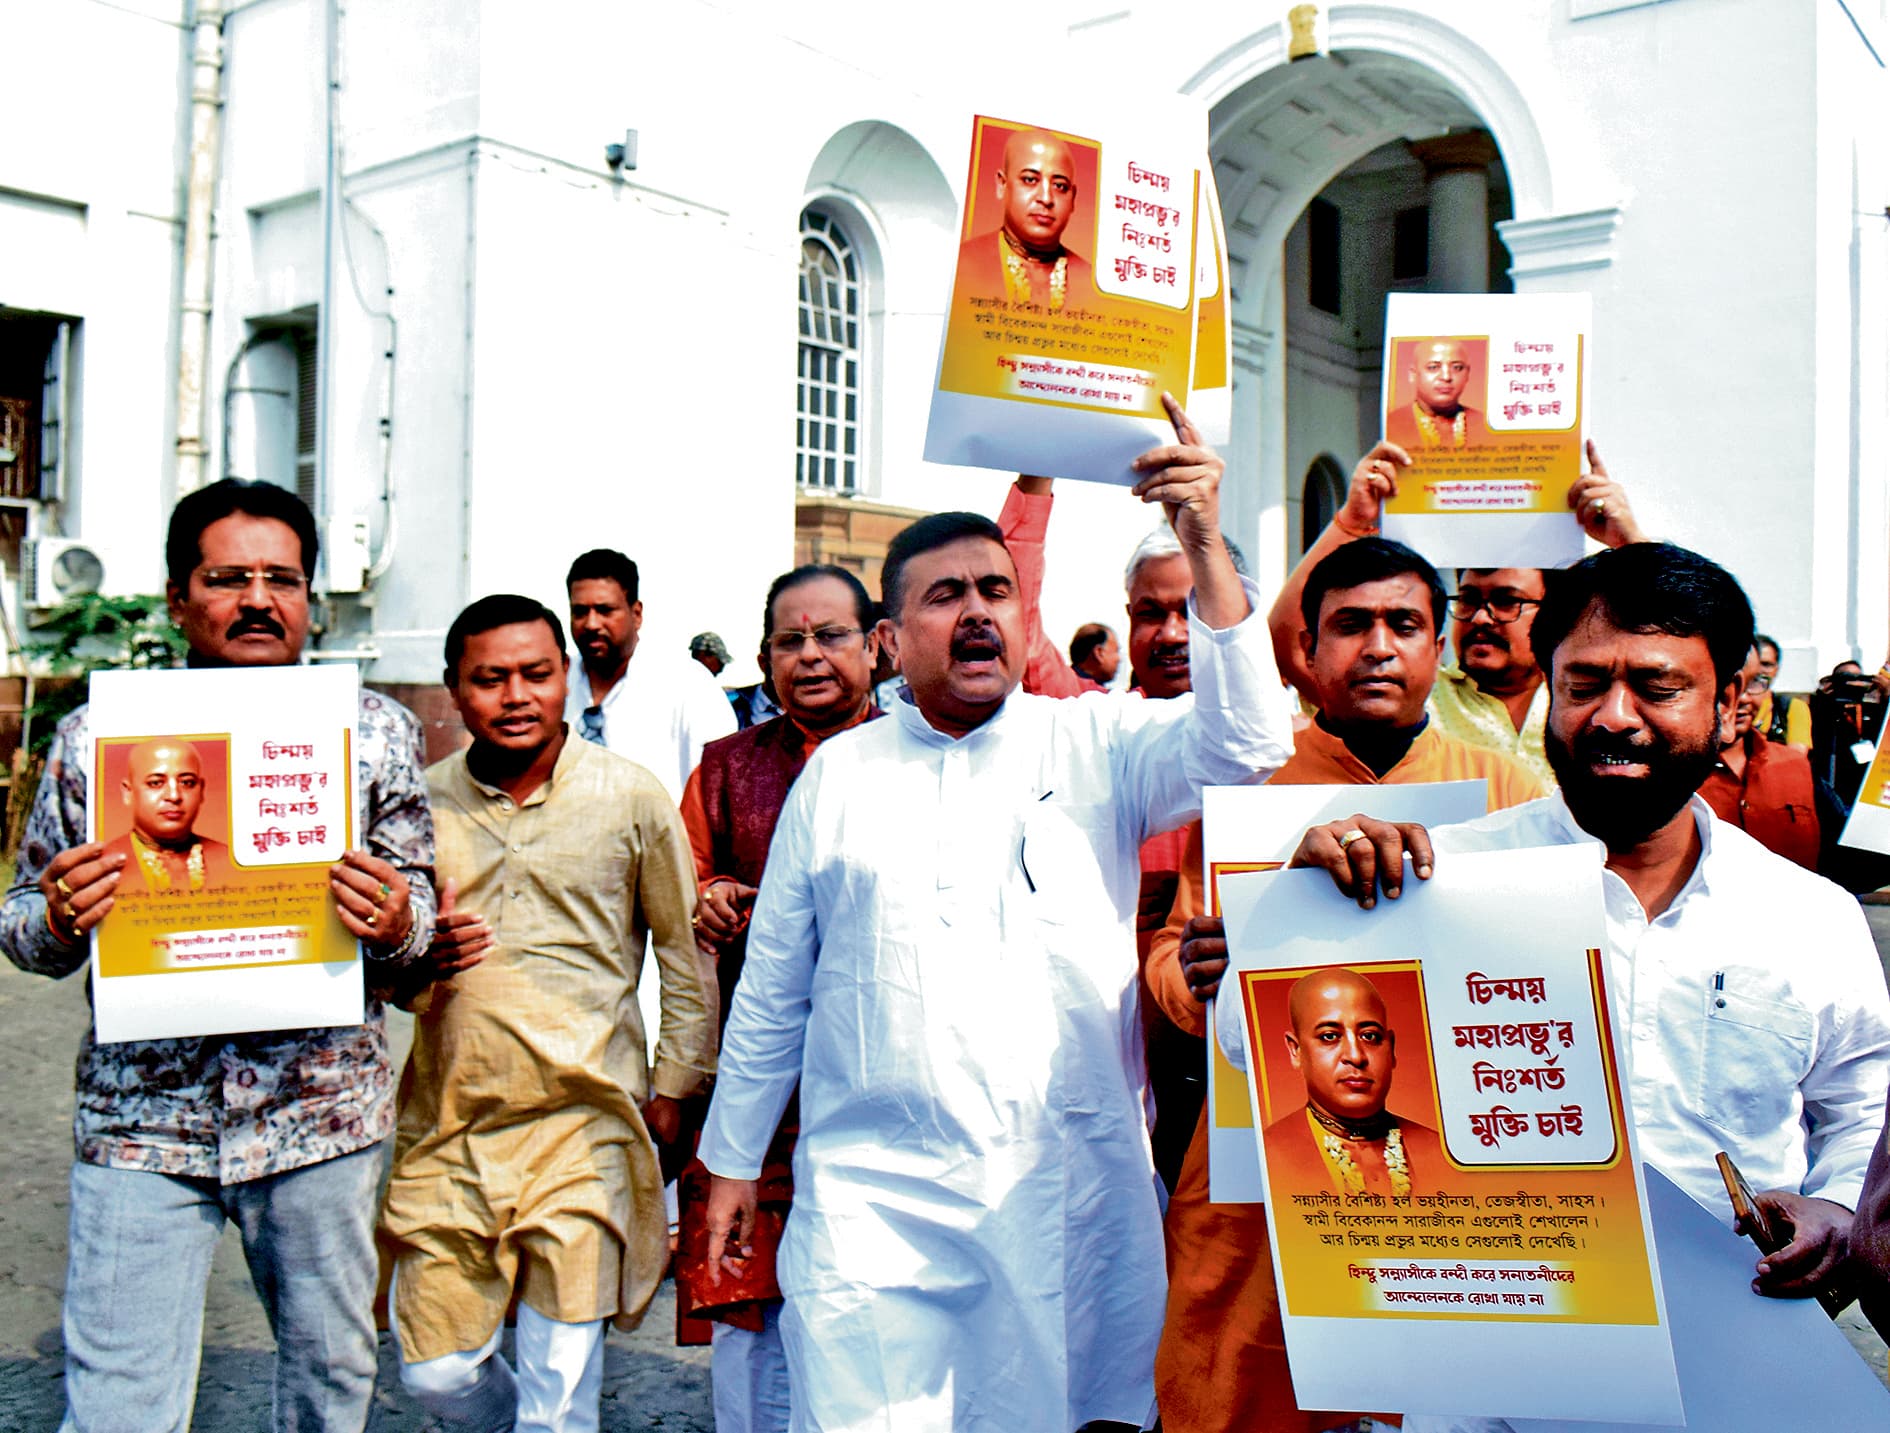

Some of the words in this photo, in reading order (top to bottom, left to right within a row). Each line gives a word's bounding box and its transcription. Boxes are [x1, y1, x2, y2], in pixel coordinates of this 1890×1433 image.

[1128, 161, 1170, 192] চিন্ময়
[1122, 222, 1171, 253] নিঃশর্ত
[1114, 255, 1147, 282] মুক্তি
[1152, 266, 1176, 287] চাই
[262, 741, 313, 760] চিন্ময়
[259, 795, 318, 818] নিঃশর্ত
[252, 826, 291, 853] মুক্তি
[297, 825, 327, 844] চাই
[1466, 972, 1546, 1005] চিন্ময়
[1473, 1054, 1566, 1094] নিঃশর্ত
[1469, 1105, 1530, 1149] মুক্তি
[1535, 1104, 1583, 1137] চাই
[1334, 1211, 1398, 1227] বিবেকানন্দ
[1403, 1211, 1464, 1228] সারাজীবন
[1320, 1234, 1344, 1246] আর
[1348, 1231, 1380, 1247] চিন্ময়
[1385, 1235, 1415, 1249] প্রভুর
[1348, 1263, 1378, 1284] হিন্দু
[1440, 1264, 1468, 1280] বন্দী
[1470, 1269, 1496, 1282] করে
[1498, 1265, 1575, 1283] সনাতনীদের
[1384, 1291, 1464, 1303] আন্দোলনকে
[1468, 1293, 1499, 1305] রোখা
[1501, 1293, 1526, 1306] যায়
[1528, 1294, 1544, 1305] না
